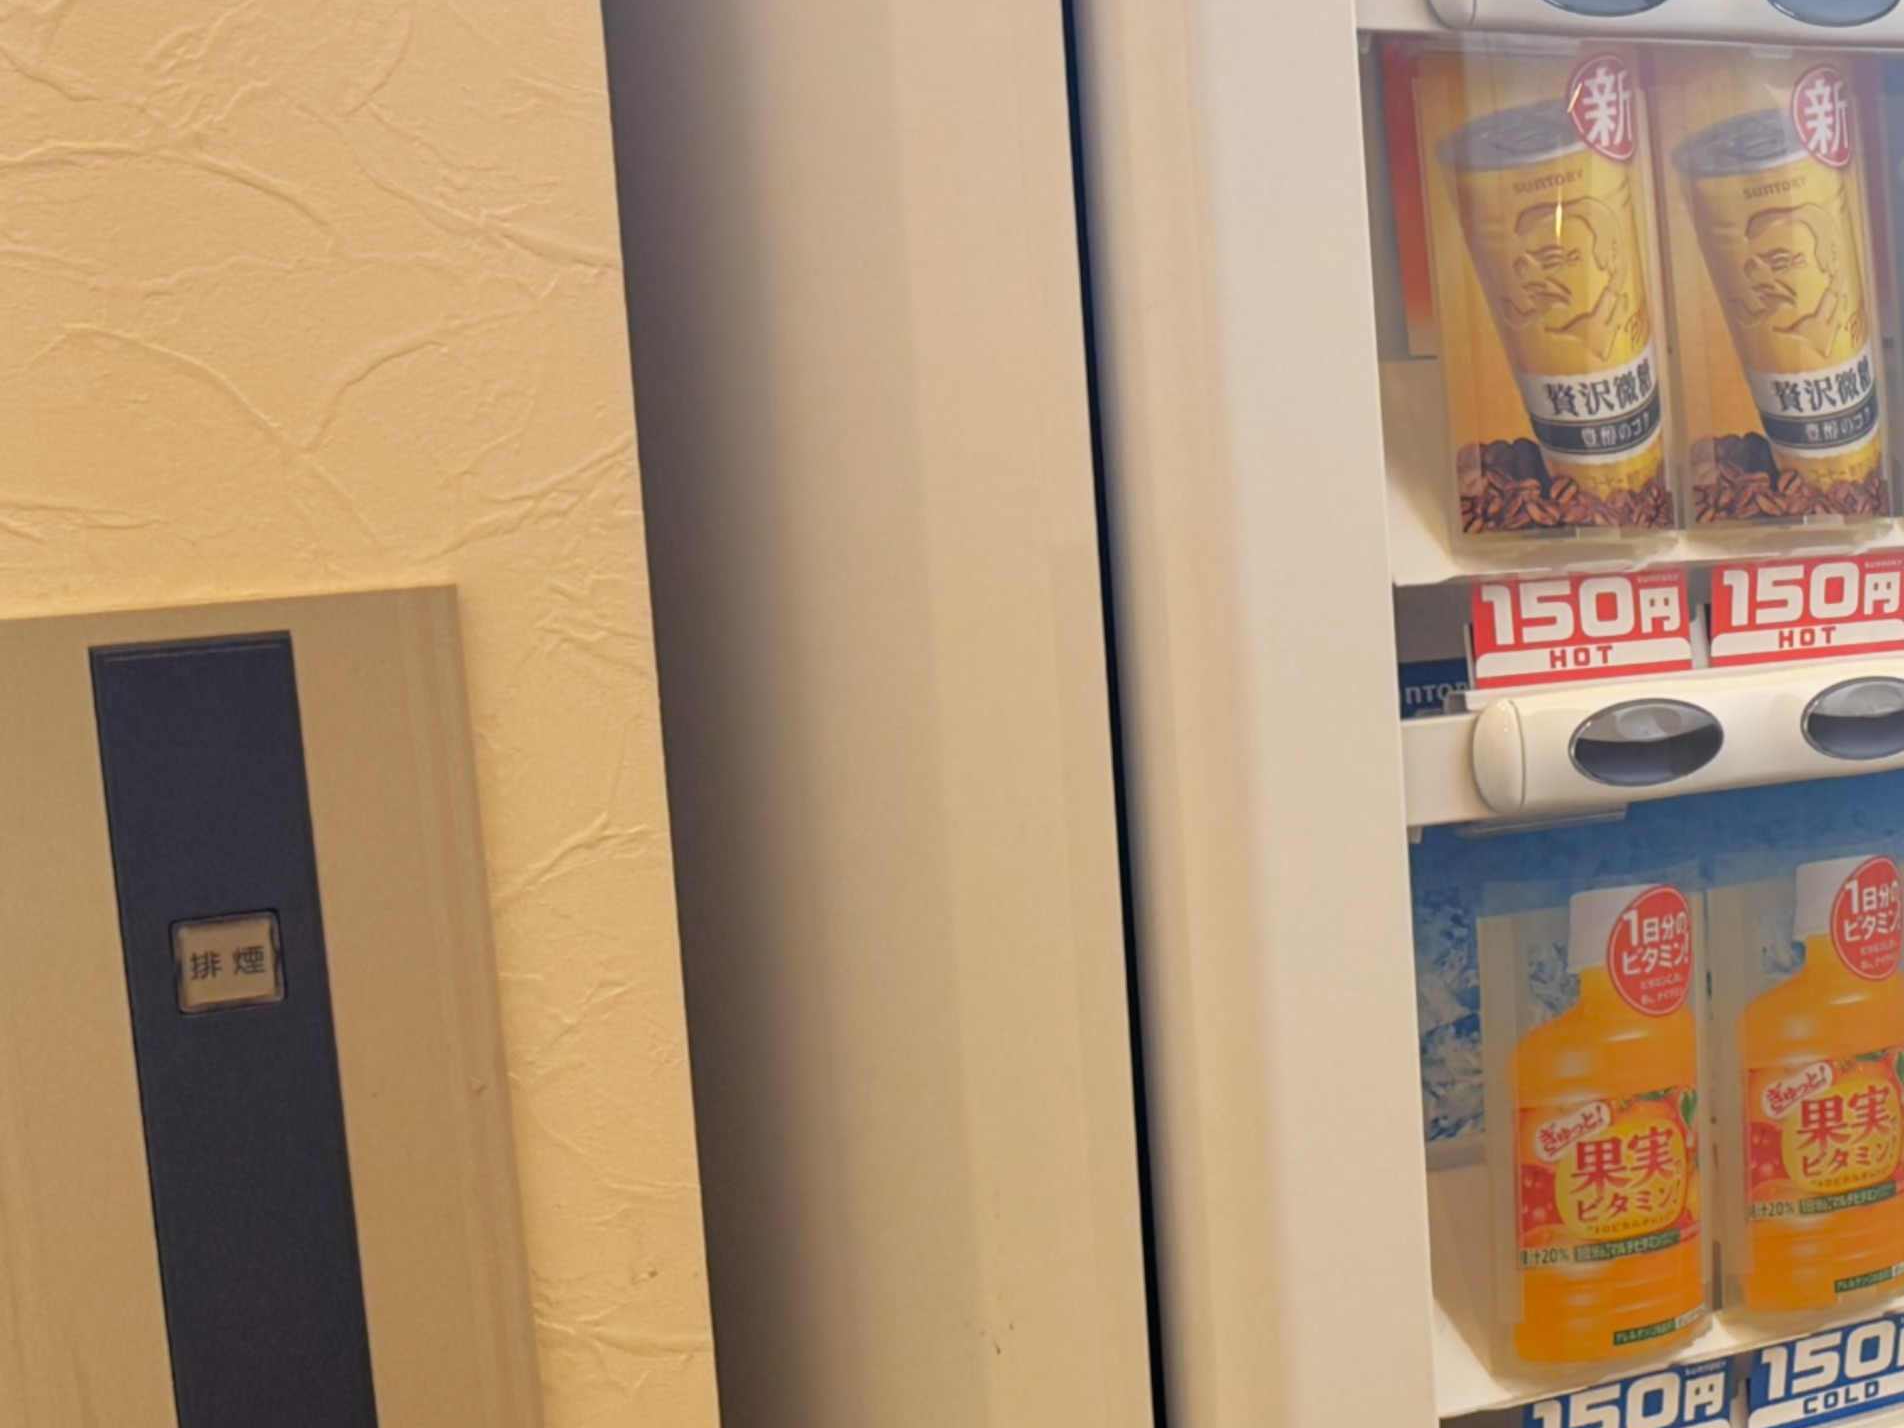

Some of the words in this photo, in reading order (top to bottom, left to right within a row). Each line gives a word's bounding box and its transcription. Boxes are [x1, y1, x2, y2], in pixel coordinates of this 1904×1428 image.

[1580, 62, 1634, 151] 新
[1804, 74, 1851, 158] 新
[1512, 169, 1584, 196] SUNTORY
[1481, 576, 1681, 646] 150円
[1719, 562, 1901, 627] 150円
[1548, 644, 1615, 670] HOT
[1778, 625, 1838, 650] HOT
[190, 945, 267, 981] 排煙
[1796, 1083, 1897, 1151] 果実
[1568, 1126, 1679, 1195] 果実
